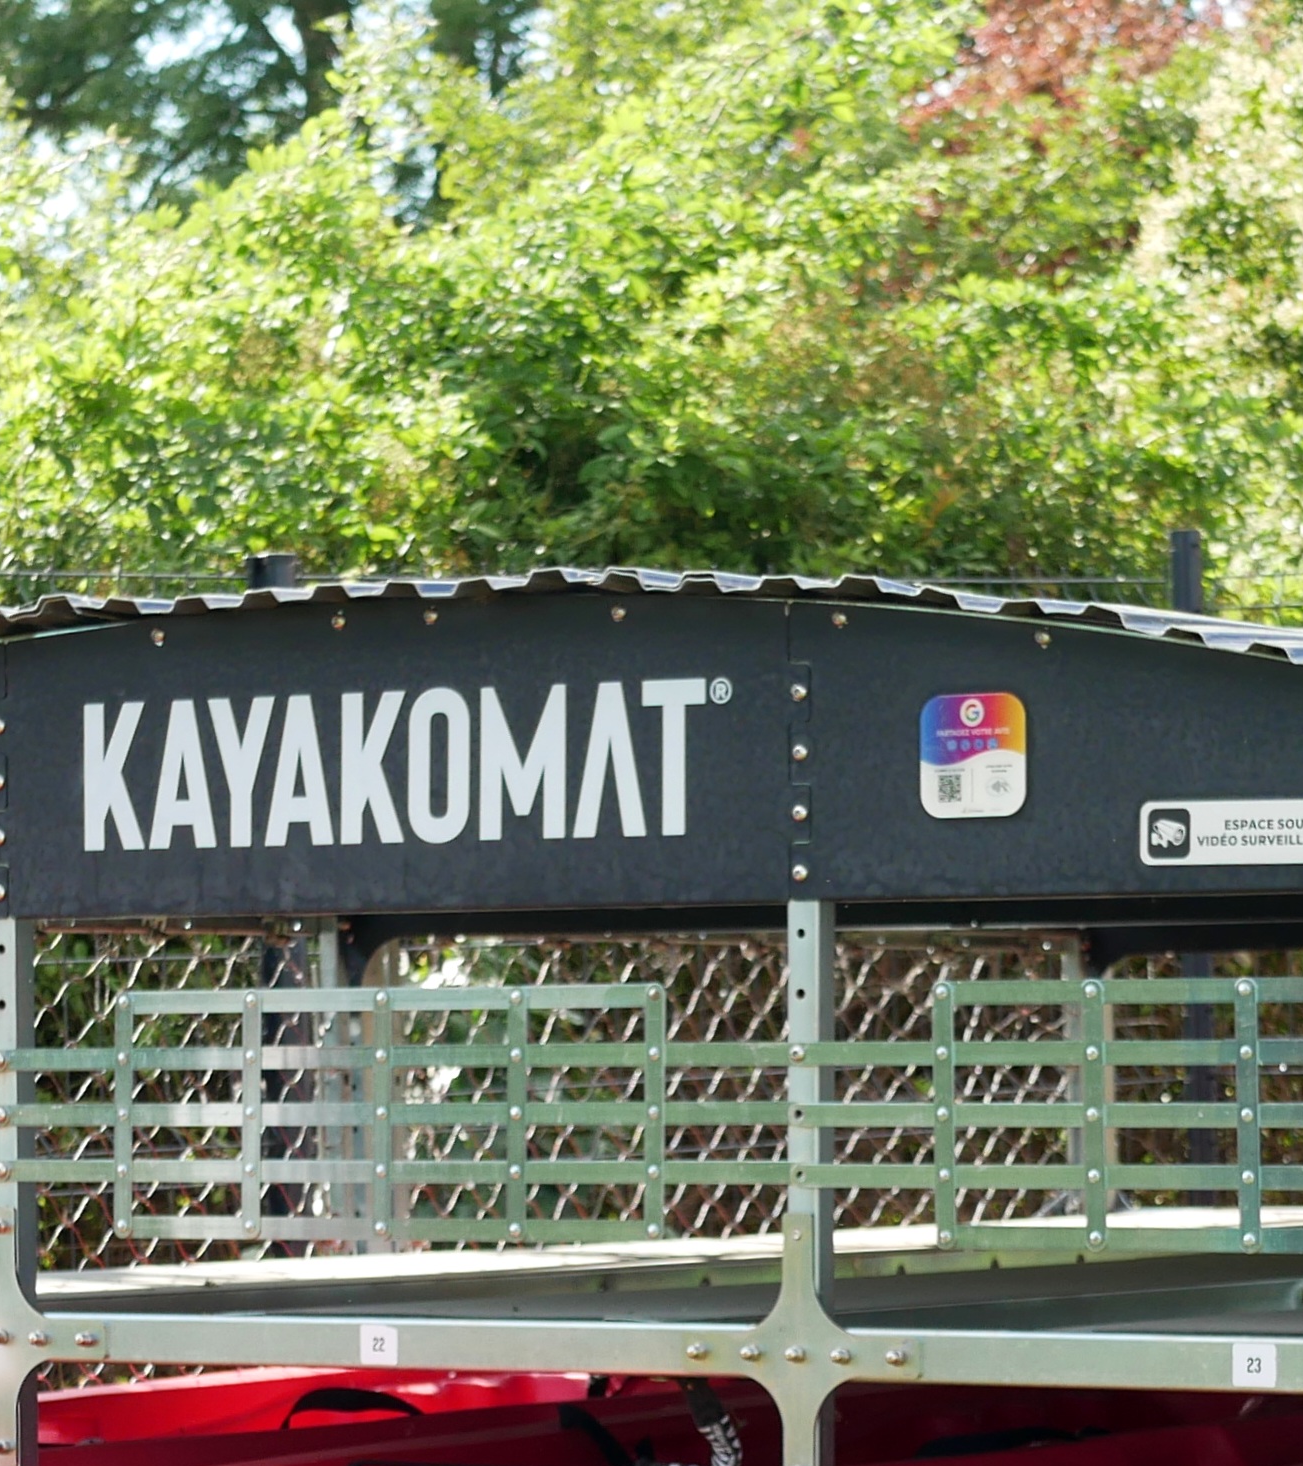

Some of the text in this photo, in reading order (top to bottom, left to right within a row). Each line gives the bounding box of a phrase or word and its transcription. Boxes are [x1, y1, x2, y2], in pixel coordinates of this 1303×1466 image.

[1224, 818, 1274, 832] ESPACE
[1197, 832, 1238, 848] VIDÉO
[372, 1336, 386, 1353] 22
[1246, 1357, 1262, 1374] 23
